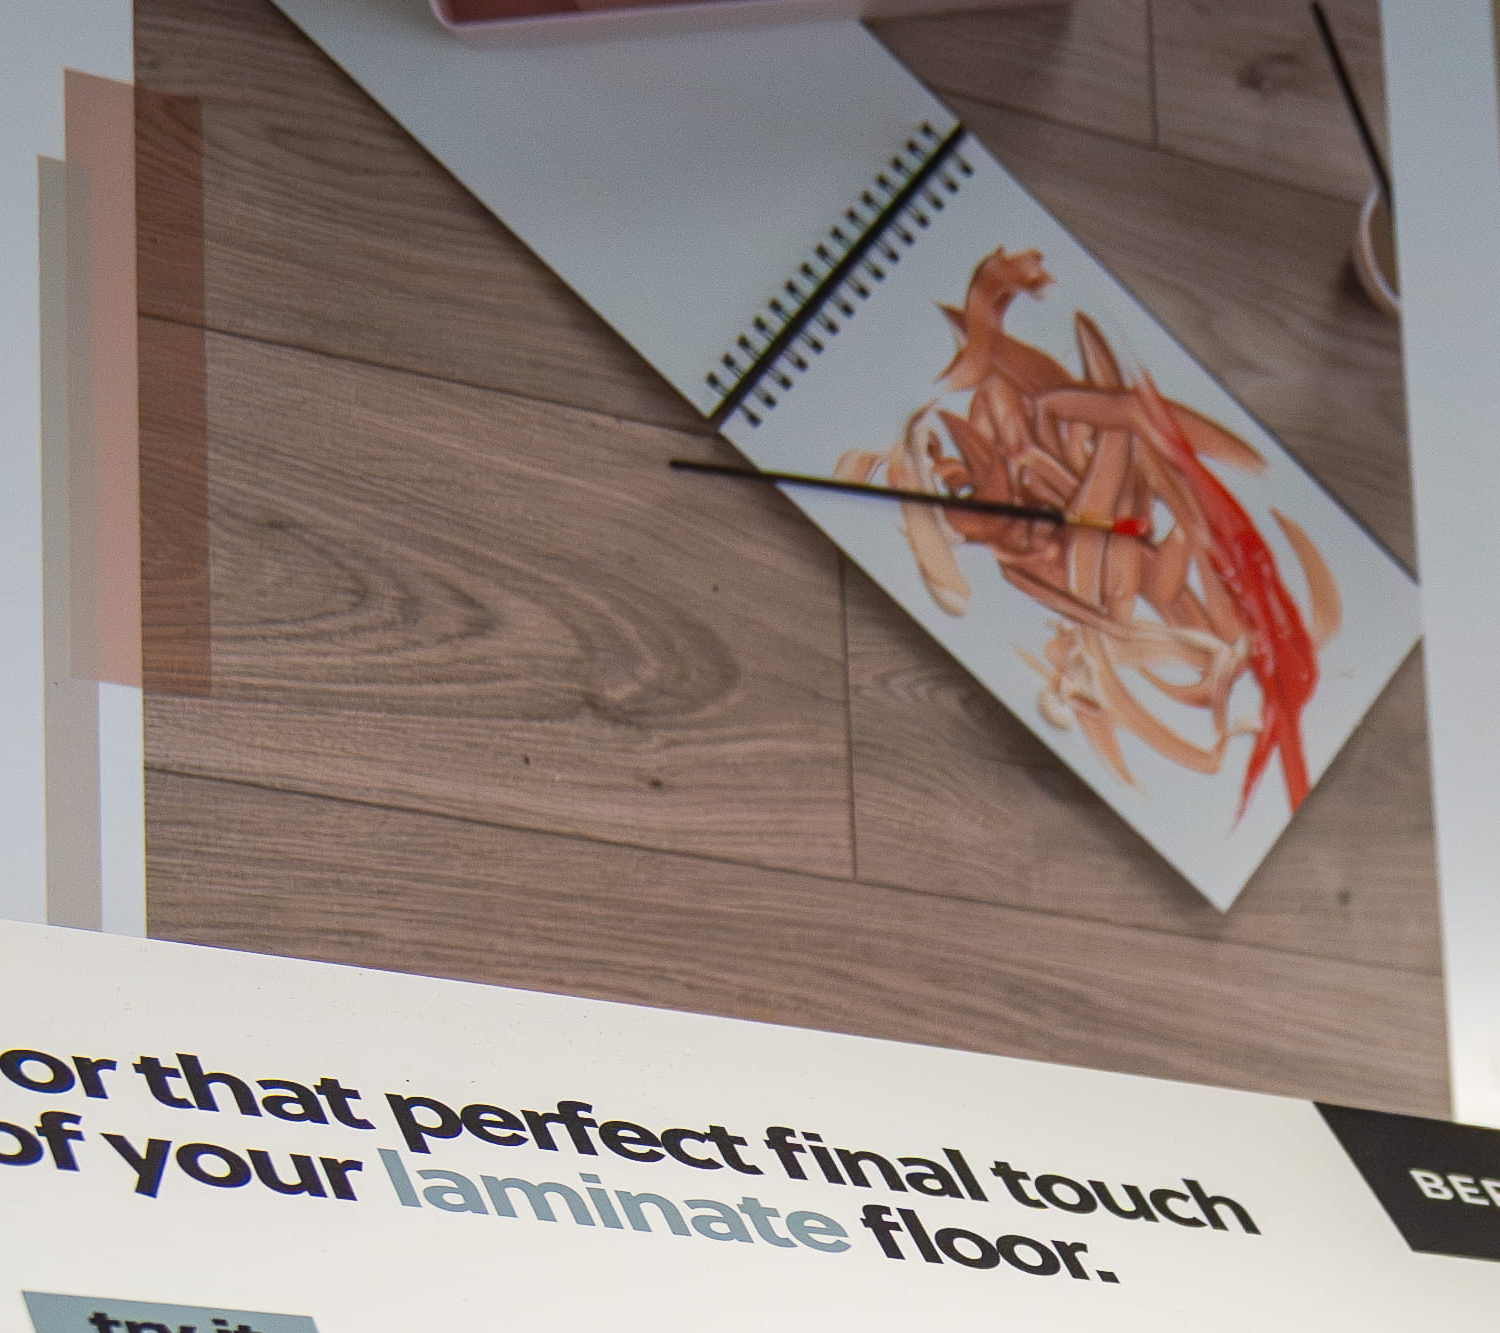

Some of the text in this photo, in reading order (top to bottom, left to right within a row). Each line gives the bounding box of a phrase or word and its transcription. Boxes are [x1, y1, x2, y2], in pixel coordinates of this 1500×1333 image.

[102, 1132, 363, 1200] your
[377, 1146, 852, 1256] laminate
[860, 1202, 1122, 1286] floor.
[134, 1051, 373, 1133] that
[385, 1086, 764, 1179] perfect
[764, 1128, 990, 1204] final
[991, 1154, 1263, 1236] touch
